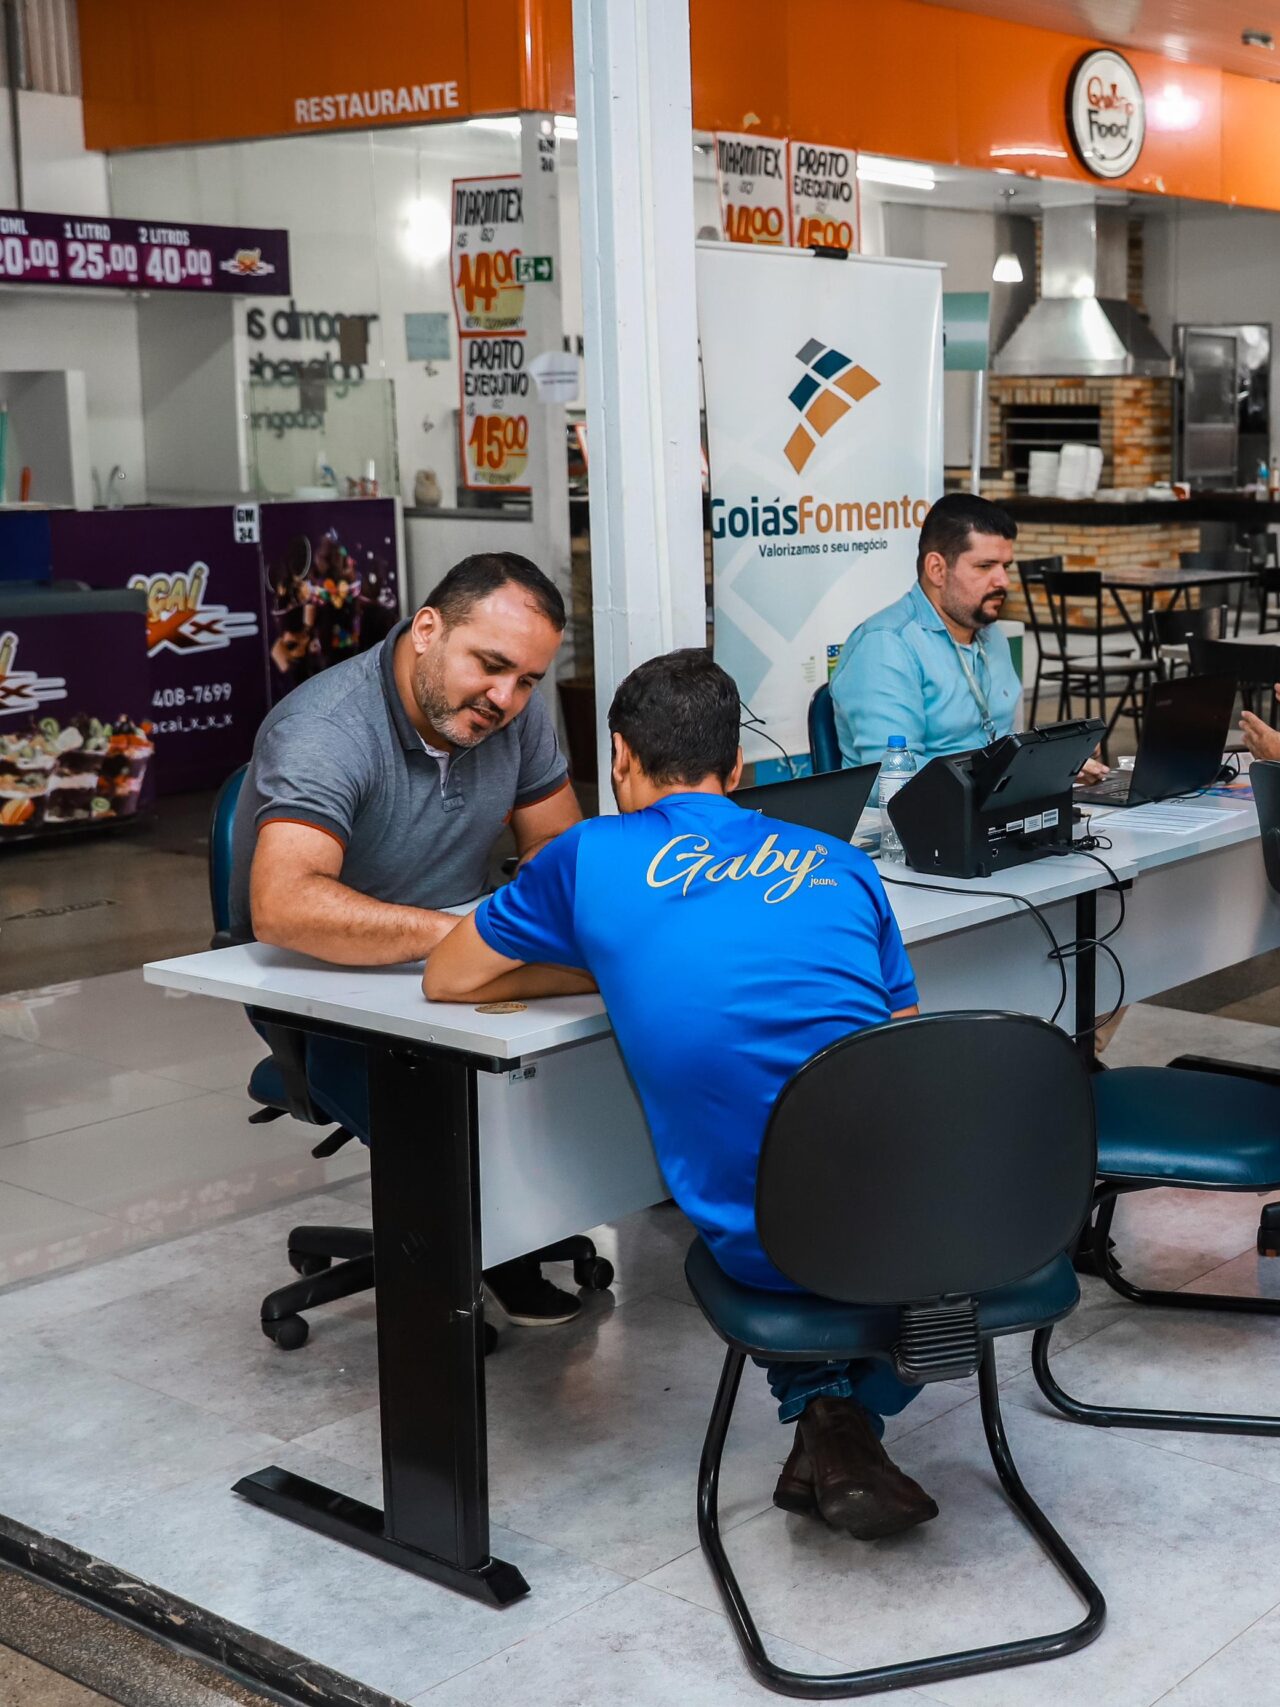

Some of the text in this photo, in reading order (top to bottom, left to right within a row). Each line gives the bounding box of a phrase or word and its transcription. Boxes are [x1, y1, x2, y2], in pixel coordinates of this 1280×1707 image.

[295, 81, 459, 124] RESTAURANTE
[1087, 108, 1131, 141] Food
[796, 146, 850, 178] PRATO
[793, 175, 853, 202] EXECUTIVO
[64, 221, 112, 242] 1 LITRO
[138, 227, 191, 247] 2 LITROS
[0, 237, 59, 276] 0,00
[67, 241, 138, 280] 25,00
[145, 247, 213, 284] 40,00
[469, 339, 525, 371] PRATO
[464, 372, 529, 397] EXECUTIVO
[759, 537, 889, 558] Valorizamos o seu negócio
